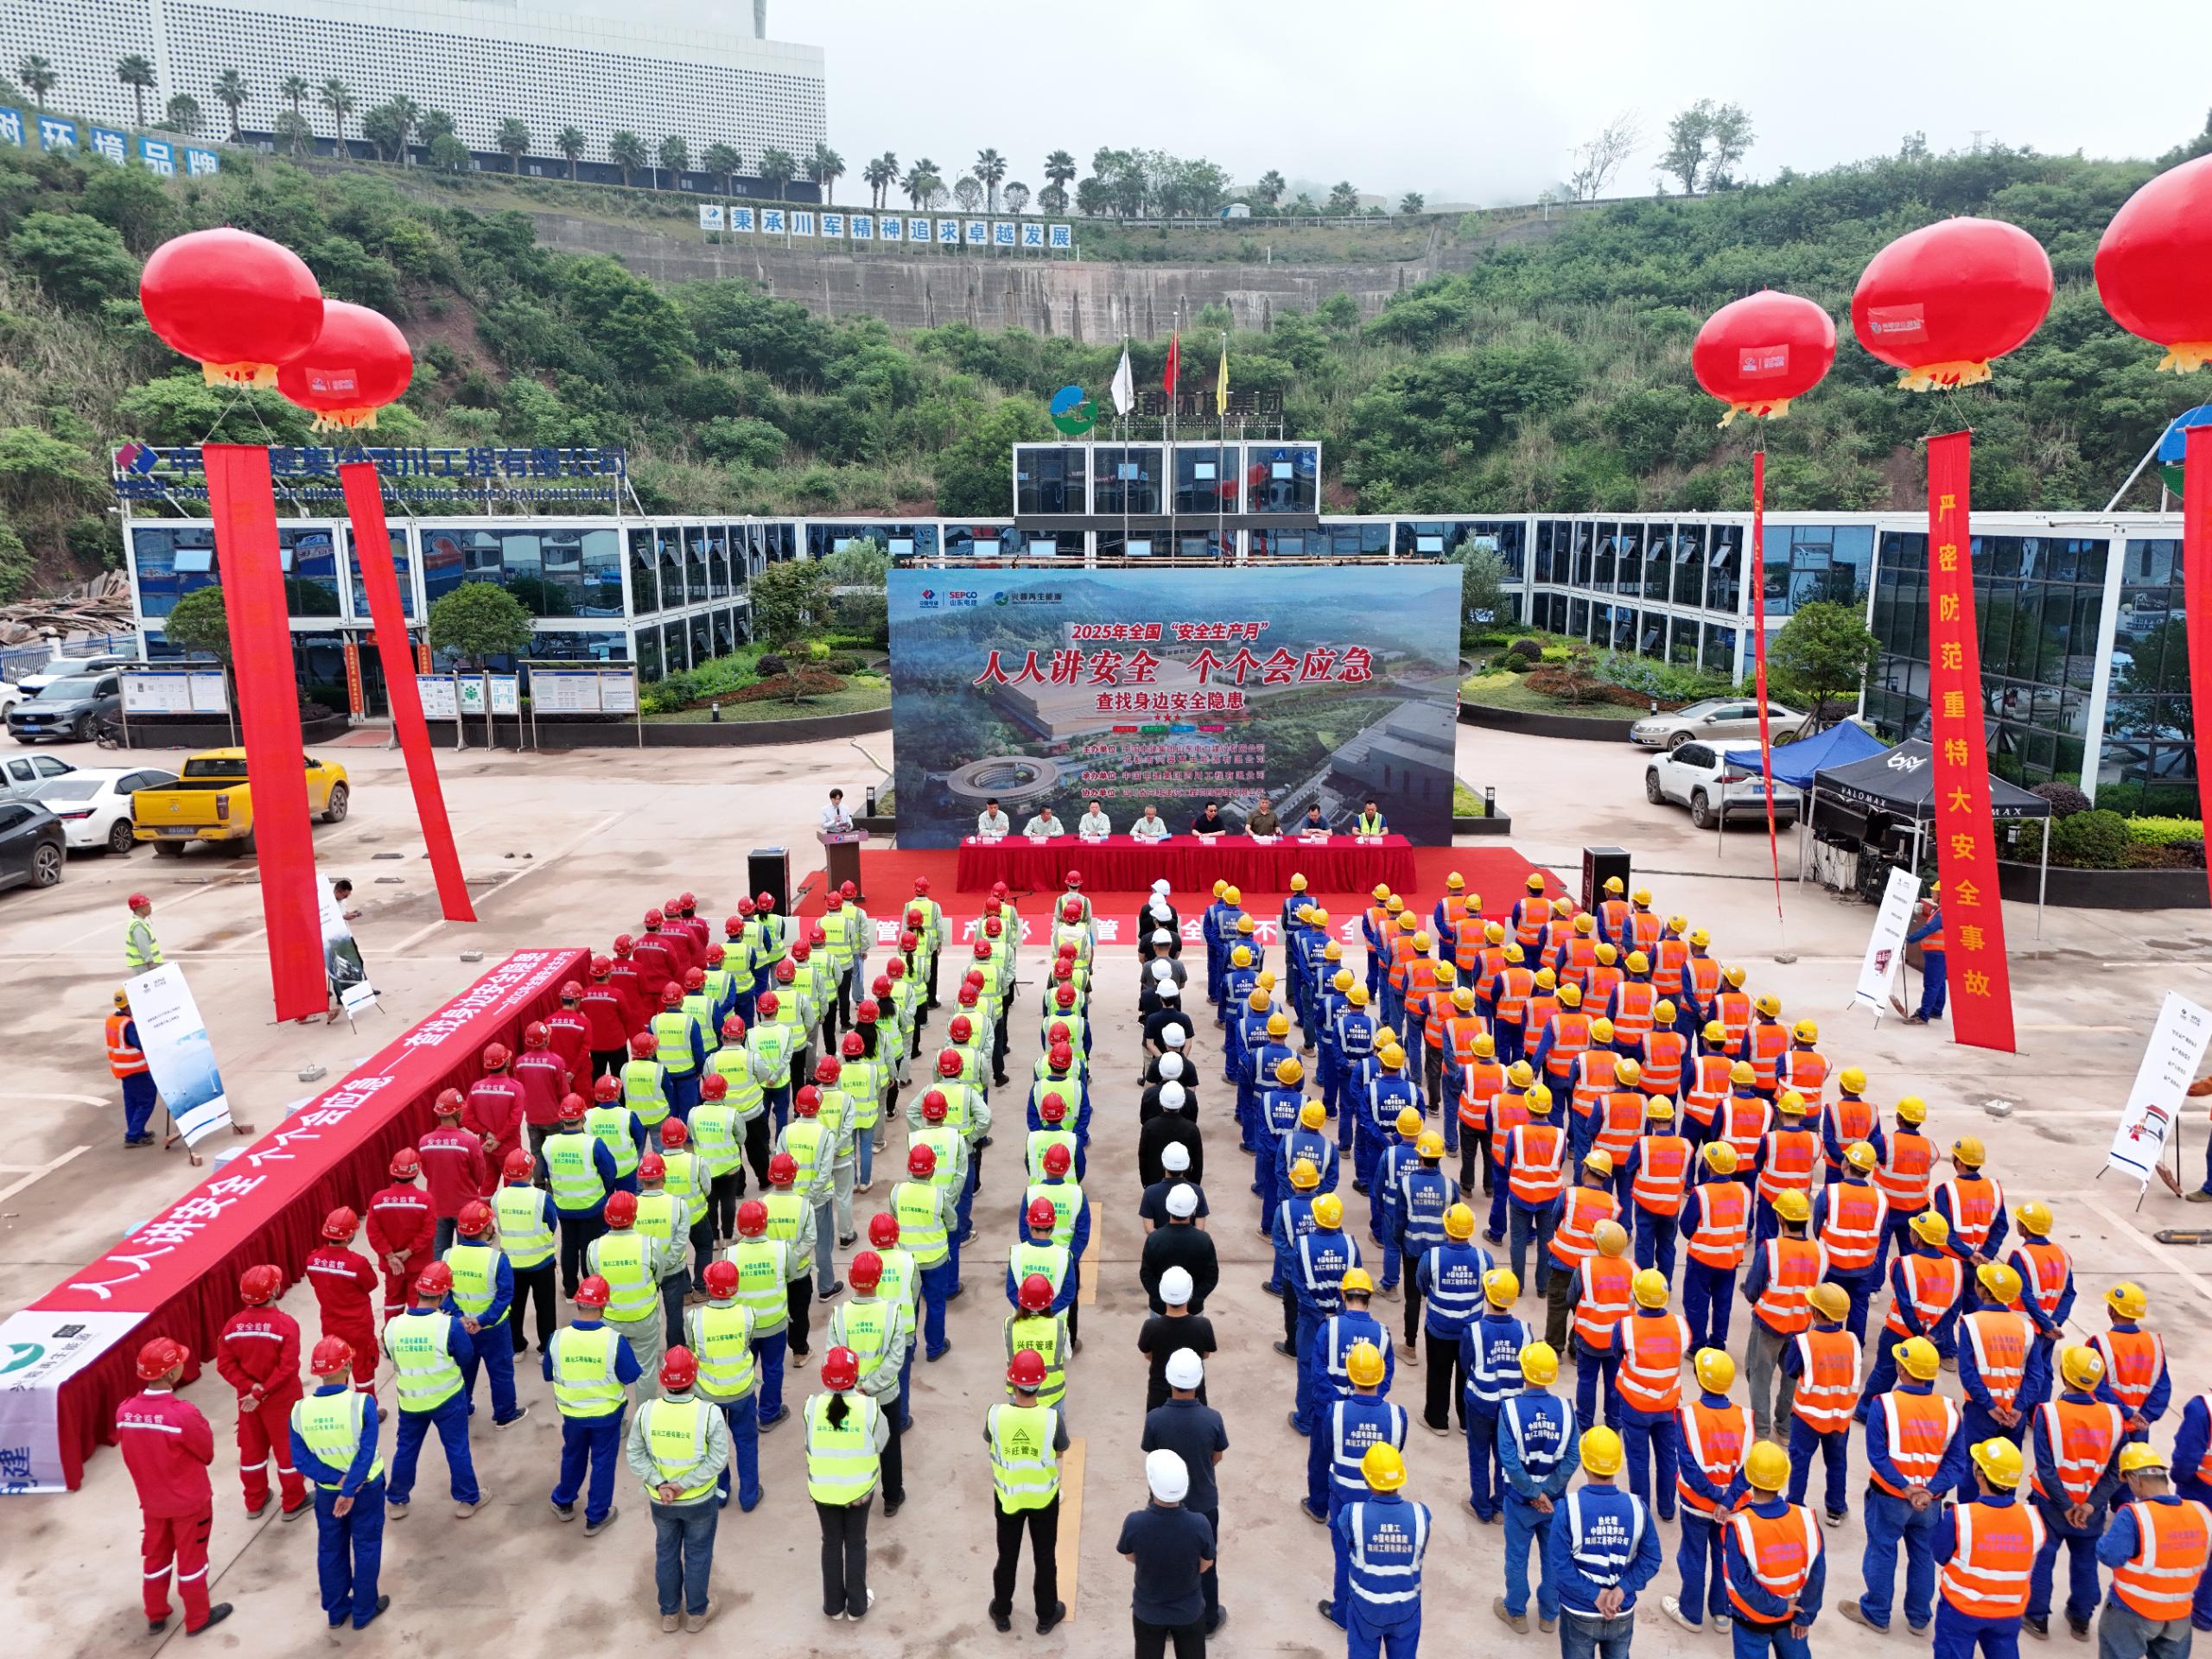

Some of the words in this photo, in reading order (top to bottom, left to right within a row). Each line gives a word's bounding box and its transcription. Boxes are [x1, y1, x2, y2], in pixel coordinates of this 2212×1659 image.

[732, 209, 1071, 247] 秉承川军精神追求卓越发展
[974, 647, 1160, 685] 人人讲安全
[1186, 645, 1374, 685] 个个会应急
[1096, 691, 1245, 711] 查找身边安全隐患
[1083, 745, 1116, 753] 主办单位
[1938, 493, 1991, 998] 严密防范重特大安全事故
[1082, 772, 1116, 780] 承办单位
[1082, 789, 1116, 798] 协办单位
[68, 1173, 268, 1300] 人人讲安全
[1017, 1340, 1053, 1351] 兴旺管理
[1004, 1446, 1039, 1457] 兴旺管理
[1598, 1516, 1618, 1526] 热处理
[1380, 1524, 1400, 1533] 起重工
[1590, 1526, 1624, 1536] 中国电建集团
[1372, 1534, 1408, 1543] 中国电建集团
[1367, 1543, 1414, 1553] 四川工程有限公司
